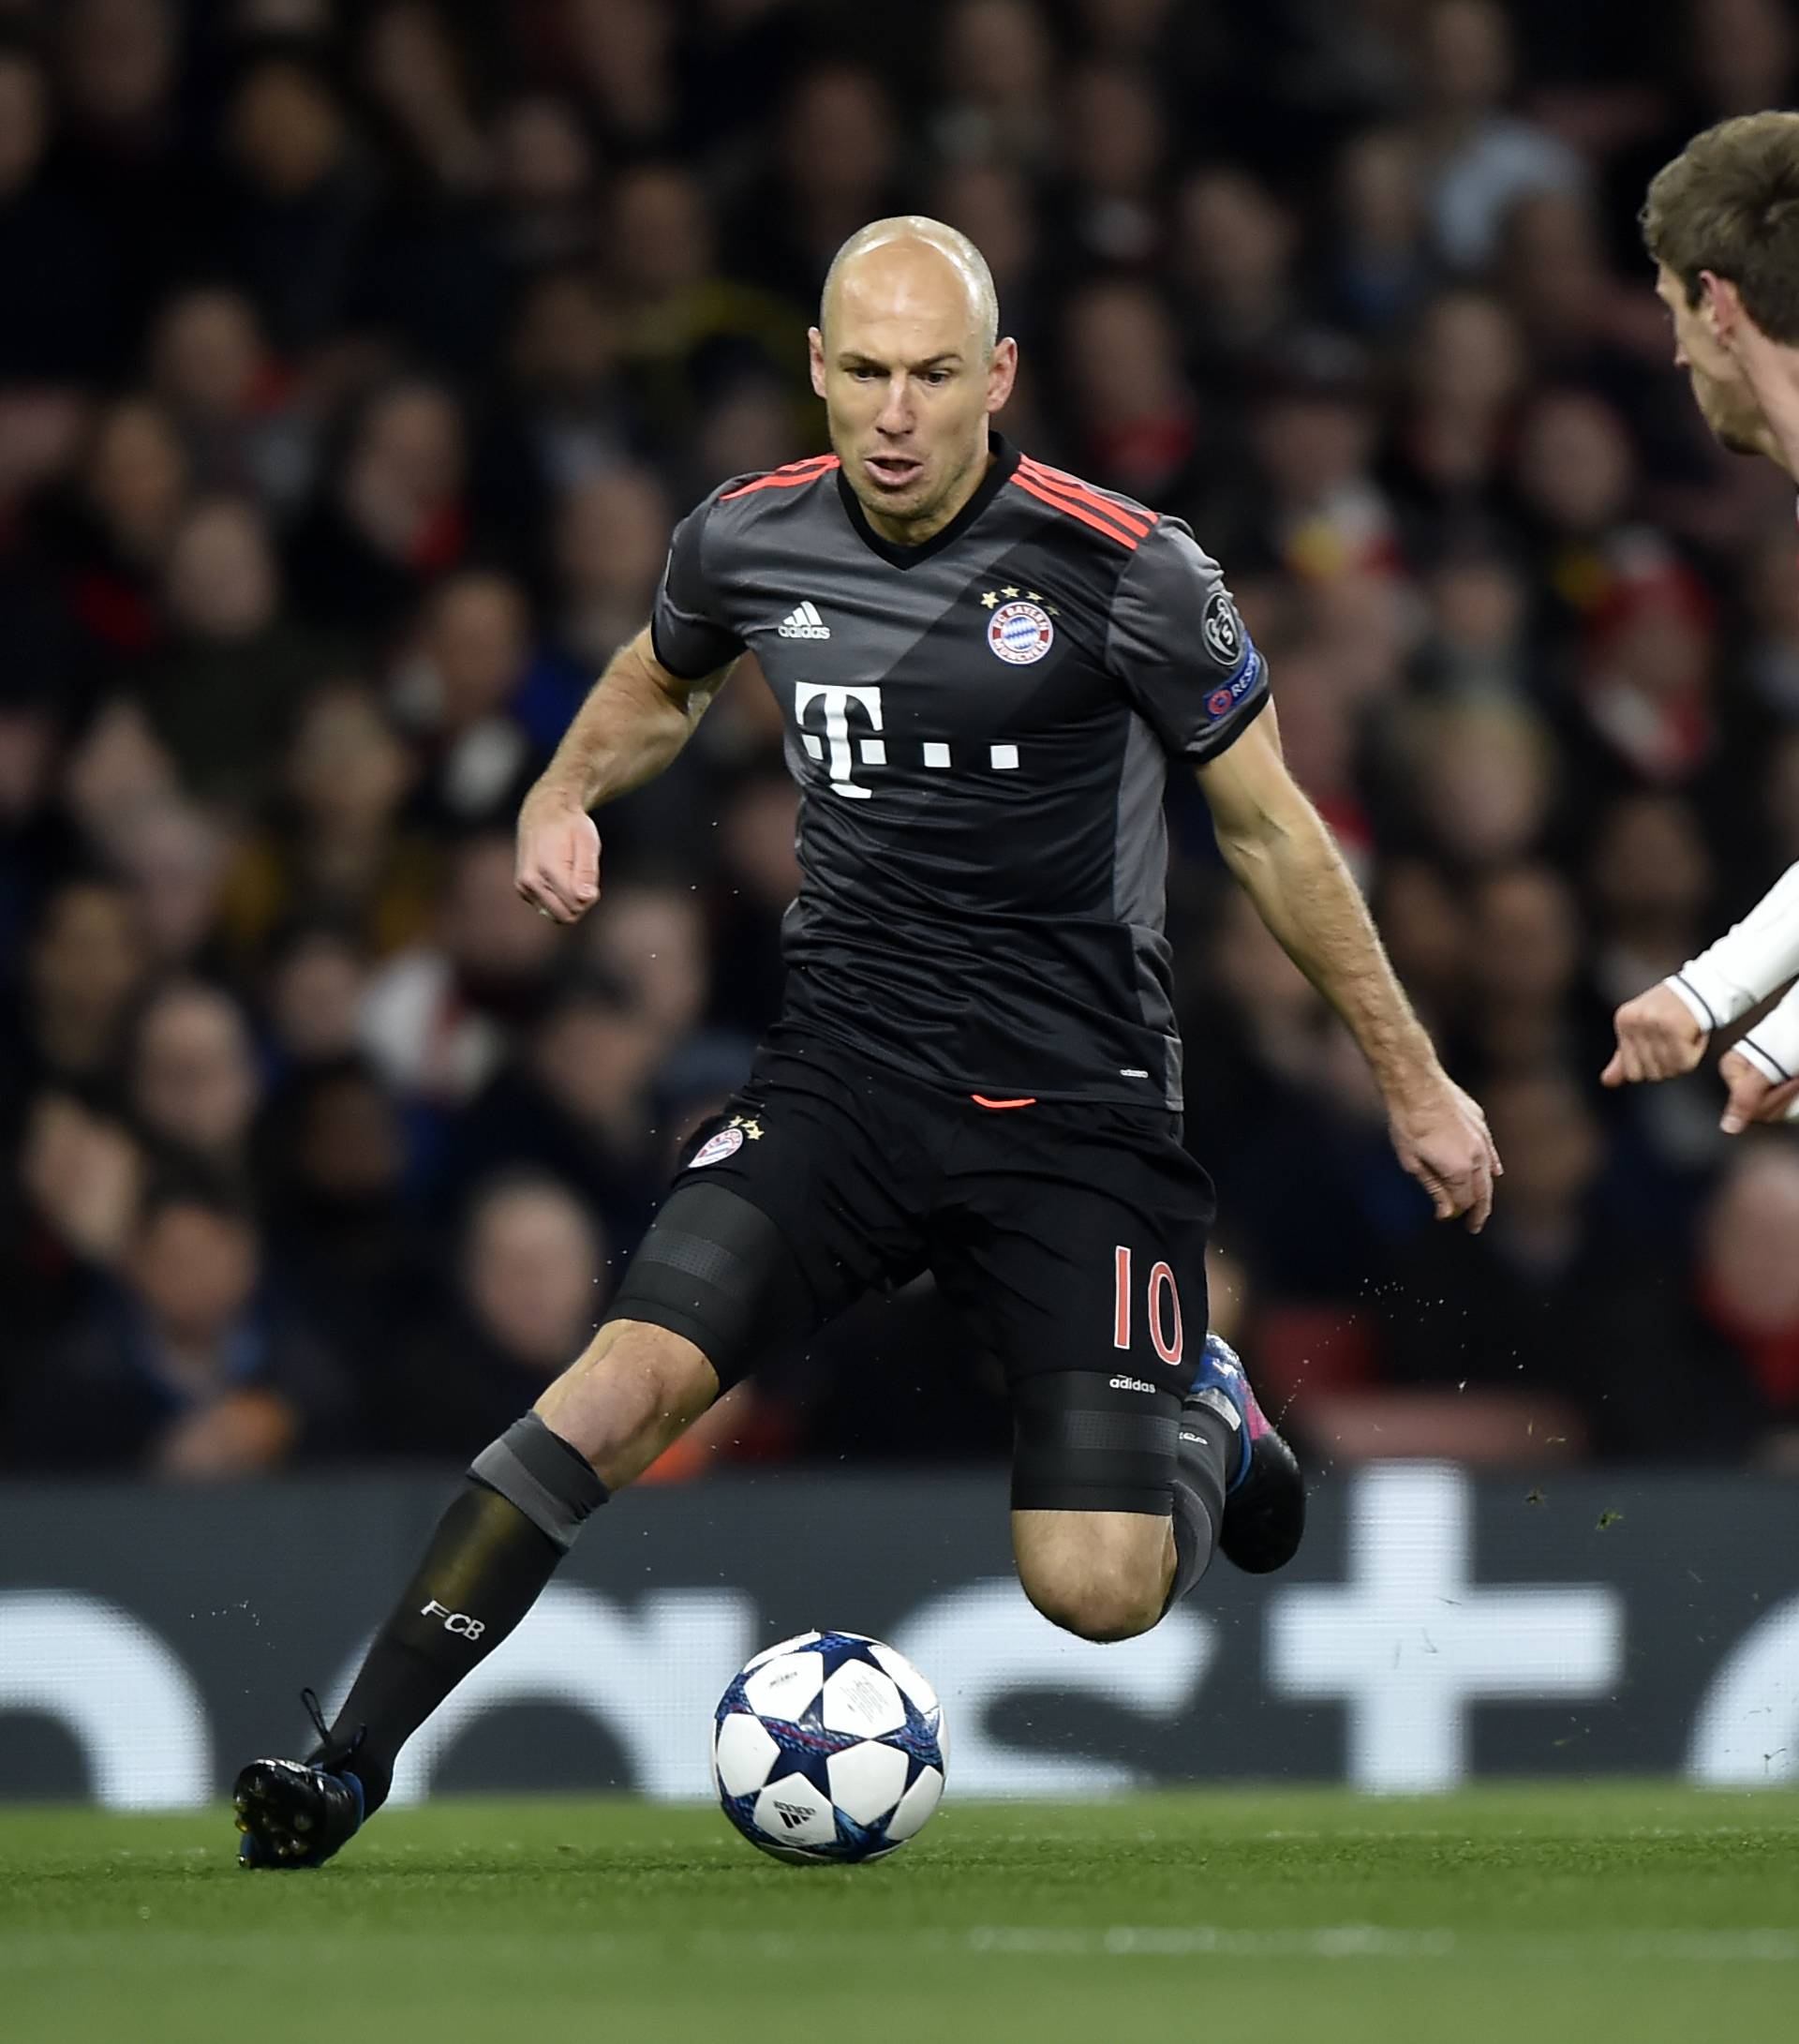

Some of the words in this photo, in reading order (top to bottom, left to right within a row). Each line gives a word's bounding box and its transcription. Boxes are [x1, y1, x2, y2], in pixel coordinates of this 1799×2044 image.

[779, 625, 831, 639] adidas
[1114, 1245, 1183, 1365] 10
[1109, 1376, 1156, 1394] adidas
[421, 1599, 485, 1641] FCB
